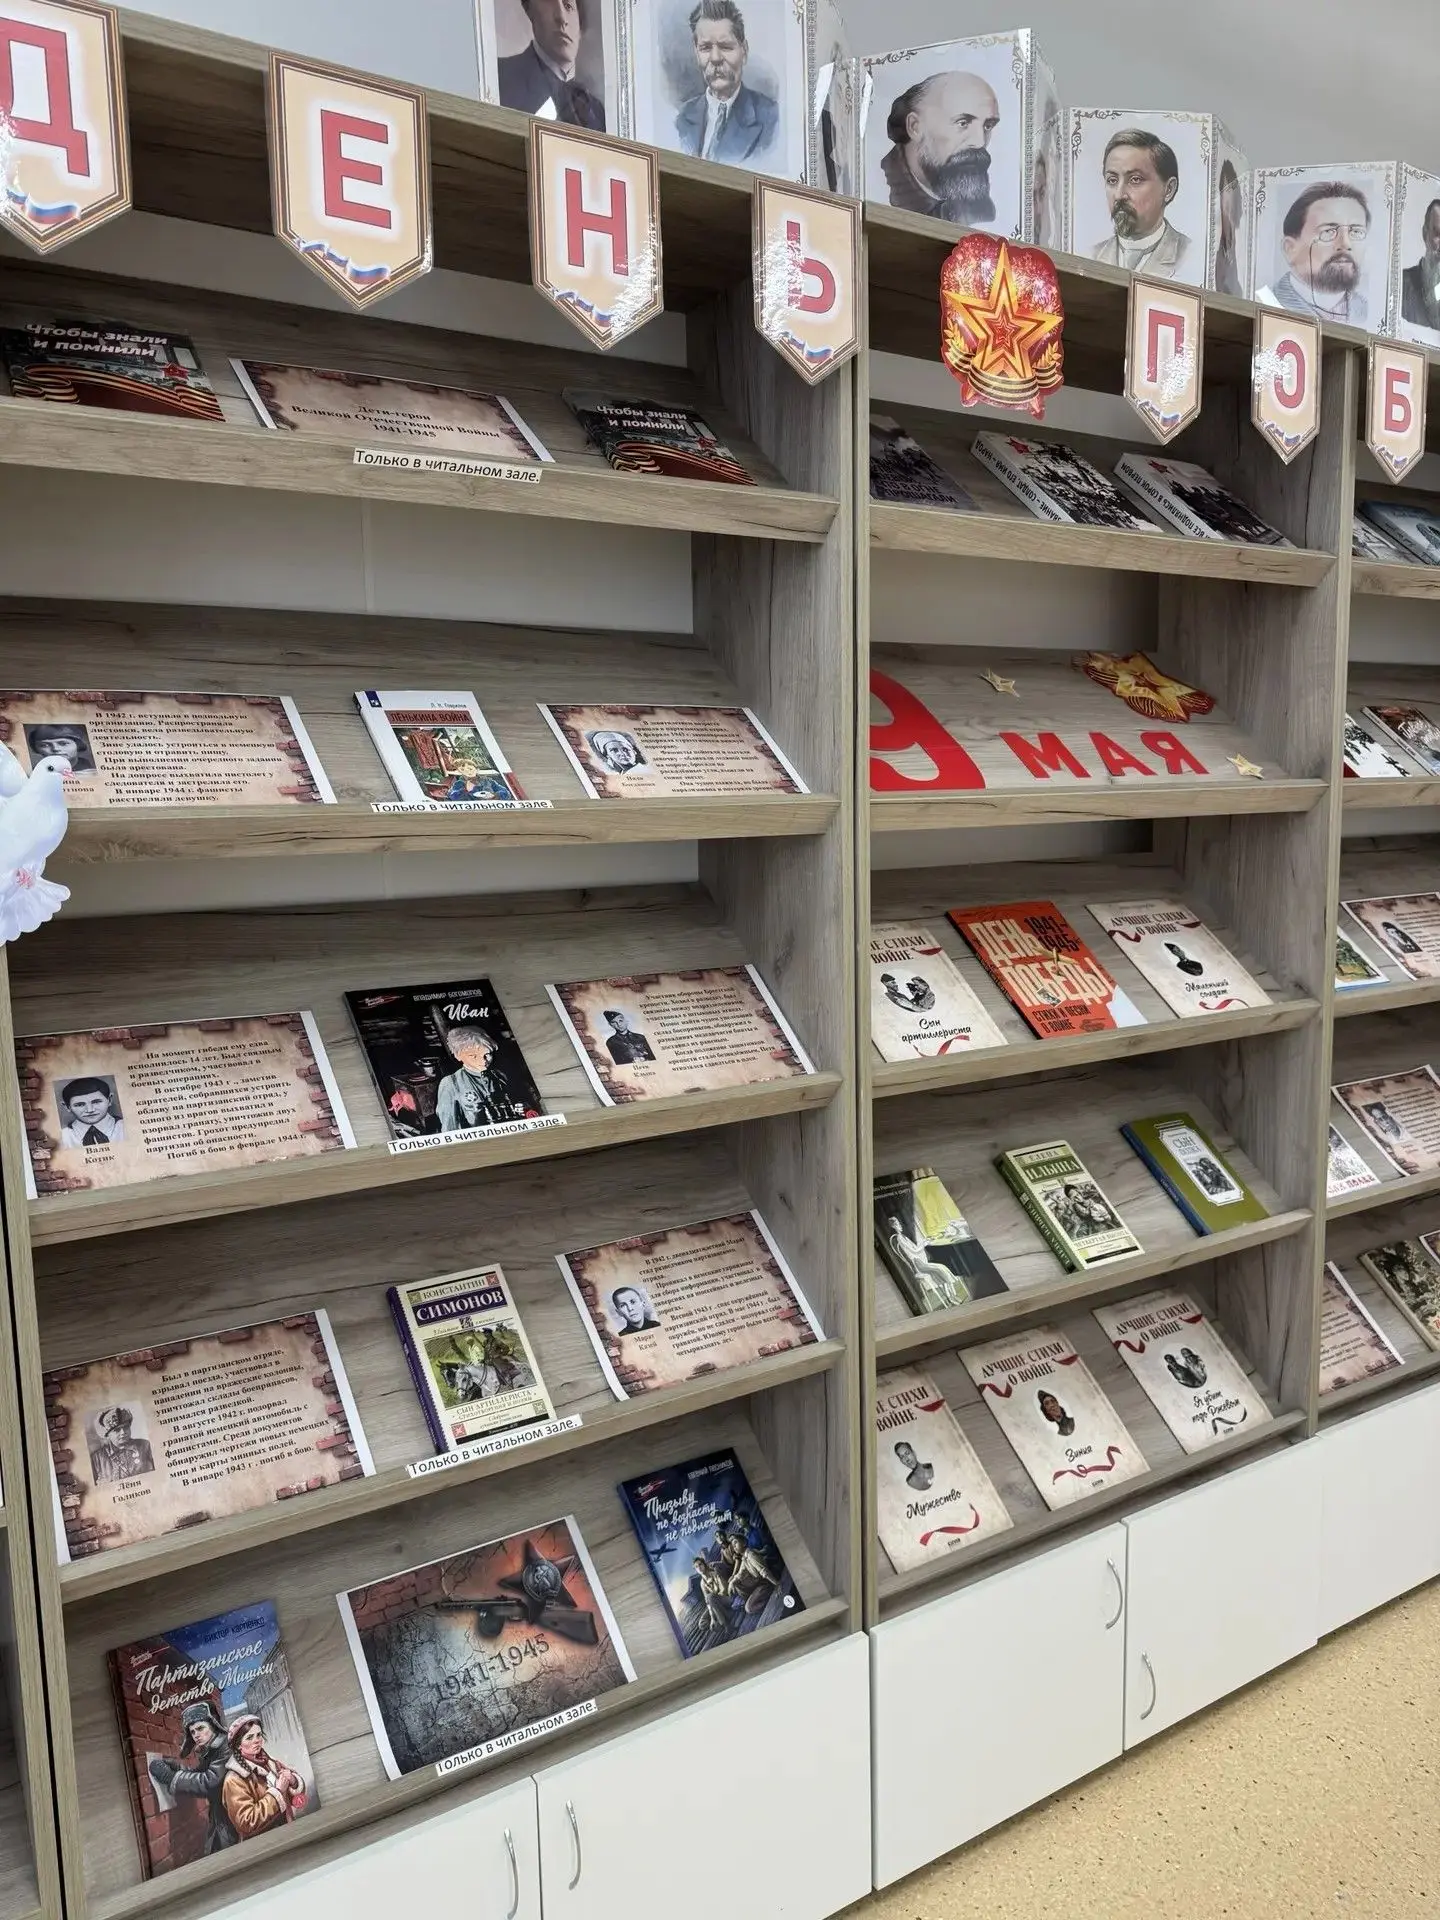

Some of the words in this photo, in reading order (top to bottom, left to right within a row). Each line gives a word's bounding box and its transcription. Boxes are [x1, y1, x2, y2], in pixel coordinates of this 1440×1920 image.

[26, 324, 99, 338] Чтобы
[104, 332, 167, 345] знали
[33, 340, 48, 348] и
[55, 341, 157, 357] помнили
[292, 405, 351, 420] Великой
[355, 413, 454, 432] Отечественной
[457, 427, 499, 438] Войны
[358, 405, 431, 421] Дети-герои
[597, 405, 643, 416] Чтобы
[648, 411, 687, 420] знали
[373, 424, 437, 438] 1941-1945
[623, 420, 685, 431] помнили
[356, 450, 409, 467] Только
[414, 460, 421, 468] в
[426, 459, 502, 478] читальном
[505, 469, 539, 483] зале.
[1041, 502, 1061, 521] ВАНИЕ
[999, 731, 1209, 778] МАЯ
[373, 803, 425, 812] Только
[440, 801, 515, 810] читальном
[519, 801, 552, 809] зале.
[1110, 913, 1152, 927] ЛУЧШИЕ
[1153, 911, 1188, 922] СТИХИ
[1137, 926, 1145, 935] О
[1148, 922, 1180, 934] ВОЙНЕ
[884, 936, 926, 949] СТИХИ
[968, 918, 1044, 968] ДЕНЬ
[1038, 933, 1080, 952] 1945
[999, 957, 1114, 1007] ПОБЕДЫ
[442, 1004, 489, 1021] Иван
[919, 1018, 941, 1029] Сын
[1032, 1007, 1061, 1021] СТИХИ
[902, 1026, 972, 1043] артиллериста
[390, 1137, 441, 1152] Только
[455, 1124, 528, 1141] читальном
[531, 1118, 564, 1128] зале.
[1025, 1159, 1081, 1180] ИЛЬИНА
[422, 1279, 485, 1300] КОНСТАНТИН
[416, 1291, 504, 1321] СИМОНОВ
[1115, 1312, 1157, 1335] ЛУЧШИЕ
[1157, 1302, 1190, 1320] СТИХИ
[1140, 1332, 1150, 1342] О
[1149, 1320, 1183, 1340] ВОЙНЕ
[161, 1371, 181, 1382] Был
[190, 1356, 254, 1376] партизанском
[981, 1354, 1026, 1378] ЛУЧШИЕ
[1027, 1342, 1065, 1362] СТИХИ
[151, 1380, 191, 1396] взрывал
[223, 1361, 273, 1379] участвовал
[216, 1374, 262, 1391] вражеские
[1008, 1375, 1018, 1386] О
[1018, 1362, 1055, 1383] ВОЙНЕ
[154, 1398, 206, 1417] уничтожал
[206, 1389, 240, 1403] склады
[887, 1386, 930, 1409] СТИХИ
[181, 1417, 216, 1432] августе
[217, 1410, 237, 1421] 1942
[246, 1399, 288, 1415] подорвал
[222, 1428, 250, 1442] Среди
[251, 1415, 303, 1435] документов
[410, 1454, 459, 1475] Только
[463, 1452, 470, 1460] в
[473, 1431, 544, 1457] читальном
[547, 1419, 578, 1435] зале.
[1065, 1445, 1093, 1462] Зинка
[112, 1487, 151, 1504] Голиков
[644, 1489, 698, 1519] Призыву
[906, 1488, 962, 1519] Мужество
[656, 1519, 668, 1531] по
[672, 1502, 718, 1525] возрасту
[665, 1530, 678, 1542] не
[135, 1640, 263, 1695] Партизанское
[434, 1633, 550, 1700] 1941-1945
[149, 1677, 215, 1714] детство
[218, 1662, 274, 1690] Мишки
[486, 1744, 494, 1753] в
[495, 1715, 564, 1748] читальном
[567, 1702, 597, 1721] зале.
